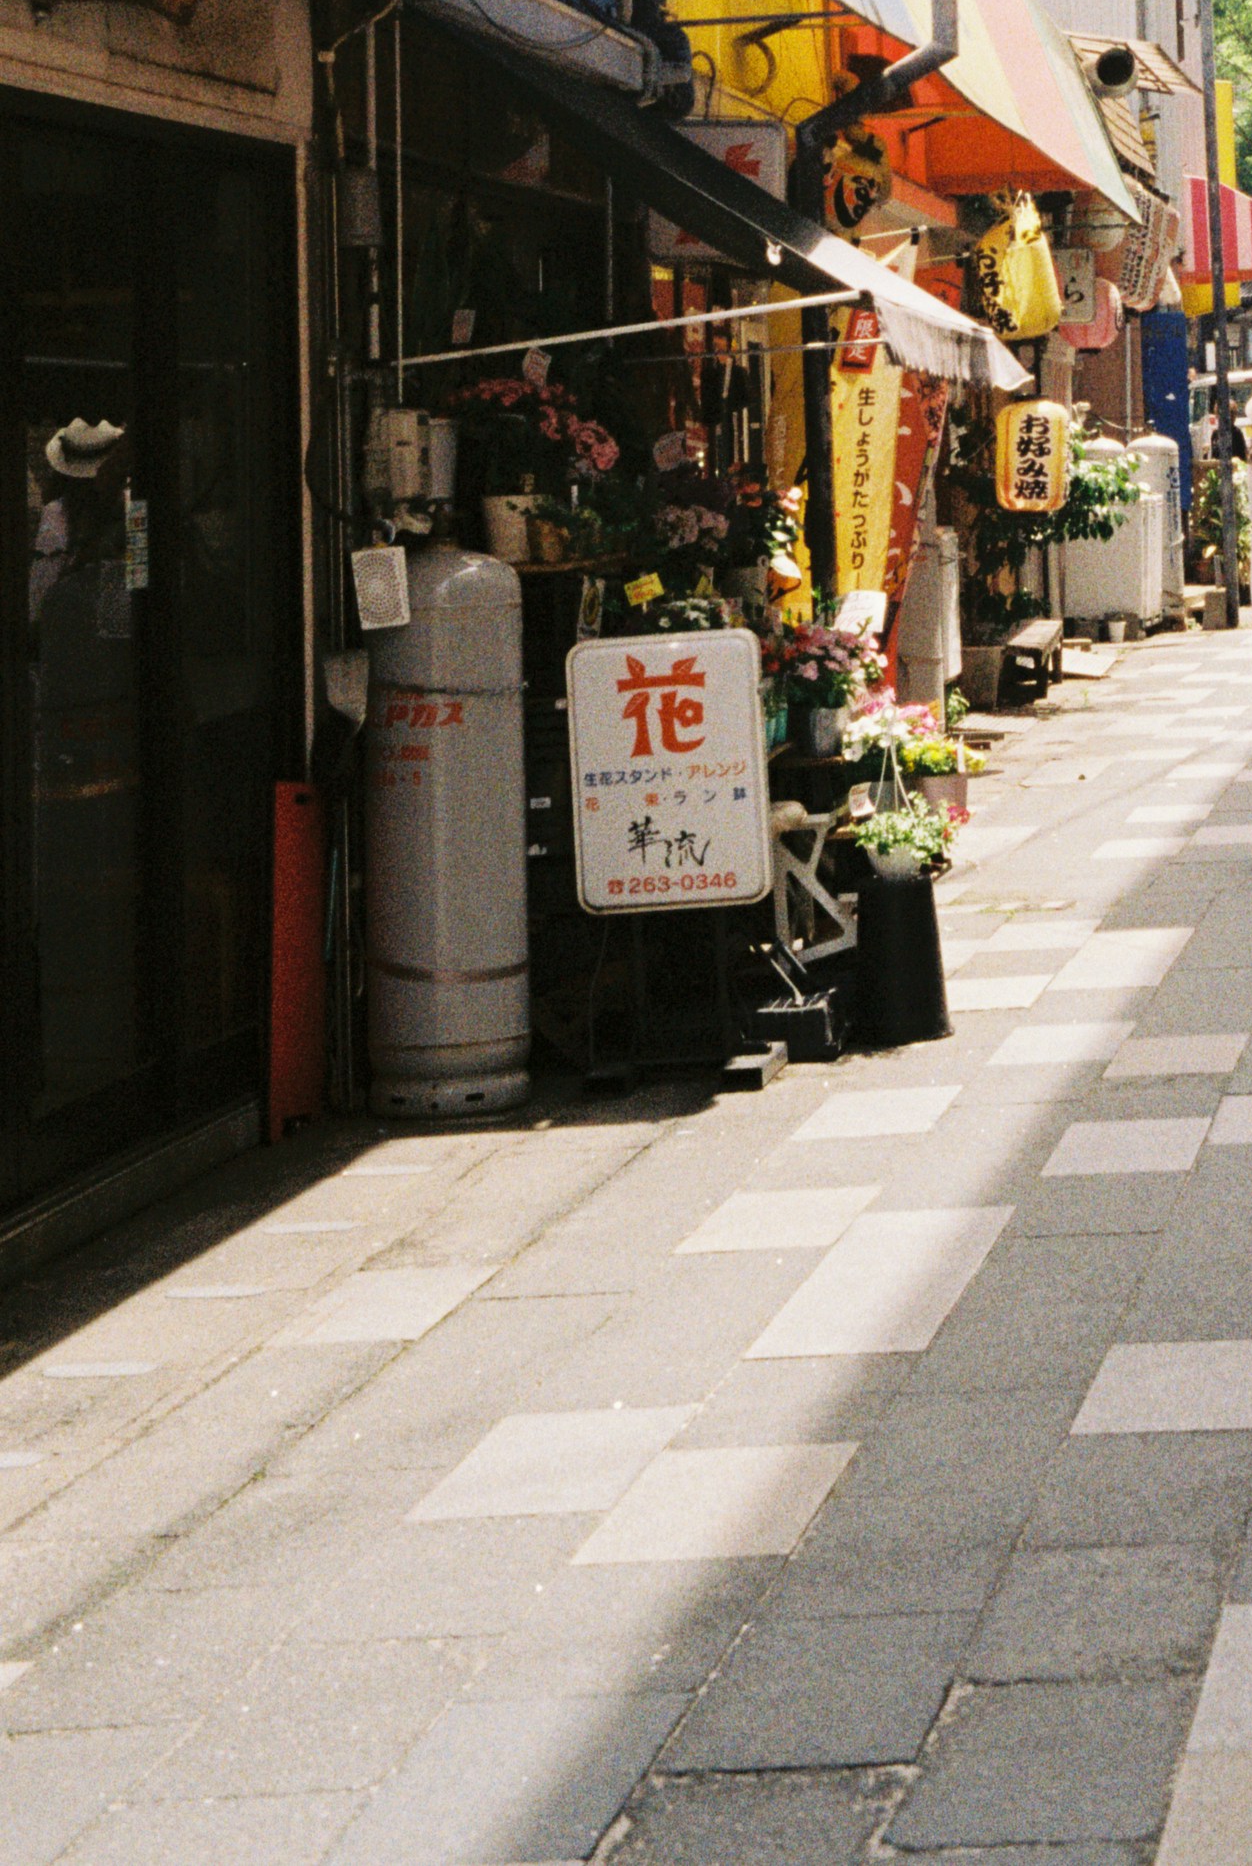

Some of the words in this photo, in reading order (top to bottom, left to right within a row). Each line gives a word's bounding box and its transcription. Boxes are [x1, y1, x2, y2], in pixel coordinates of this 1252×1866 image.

[848, 311, 874, 360] 限定
[1015, 414, 1051, 500] お好み焼
[616, 654, 706, 758] 花
[628, 871, 737, 895] 263-0346
